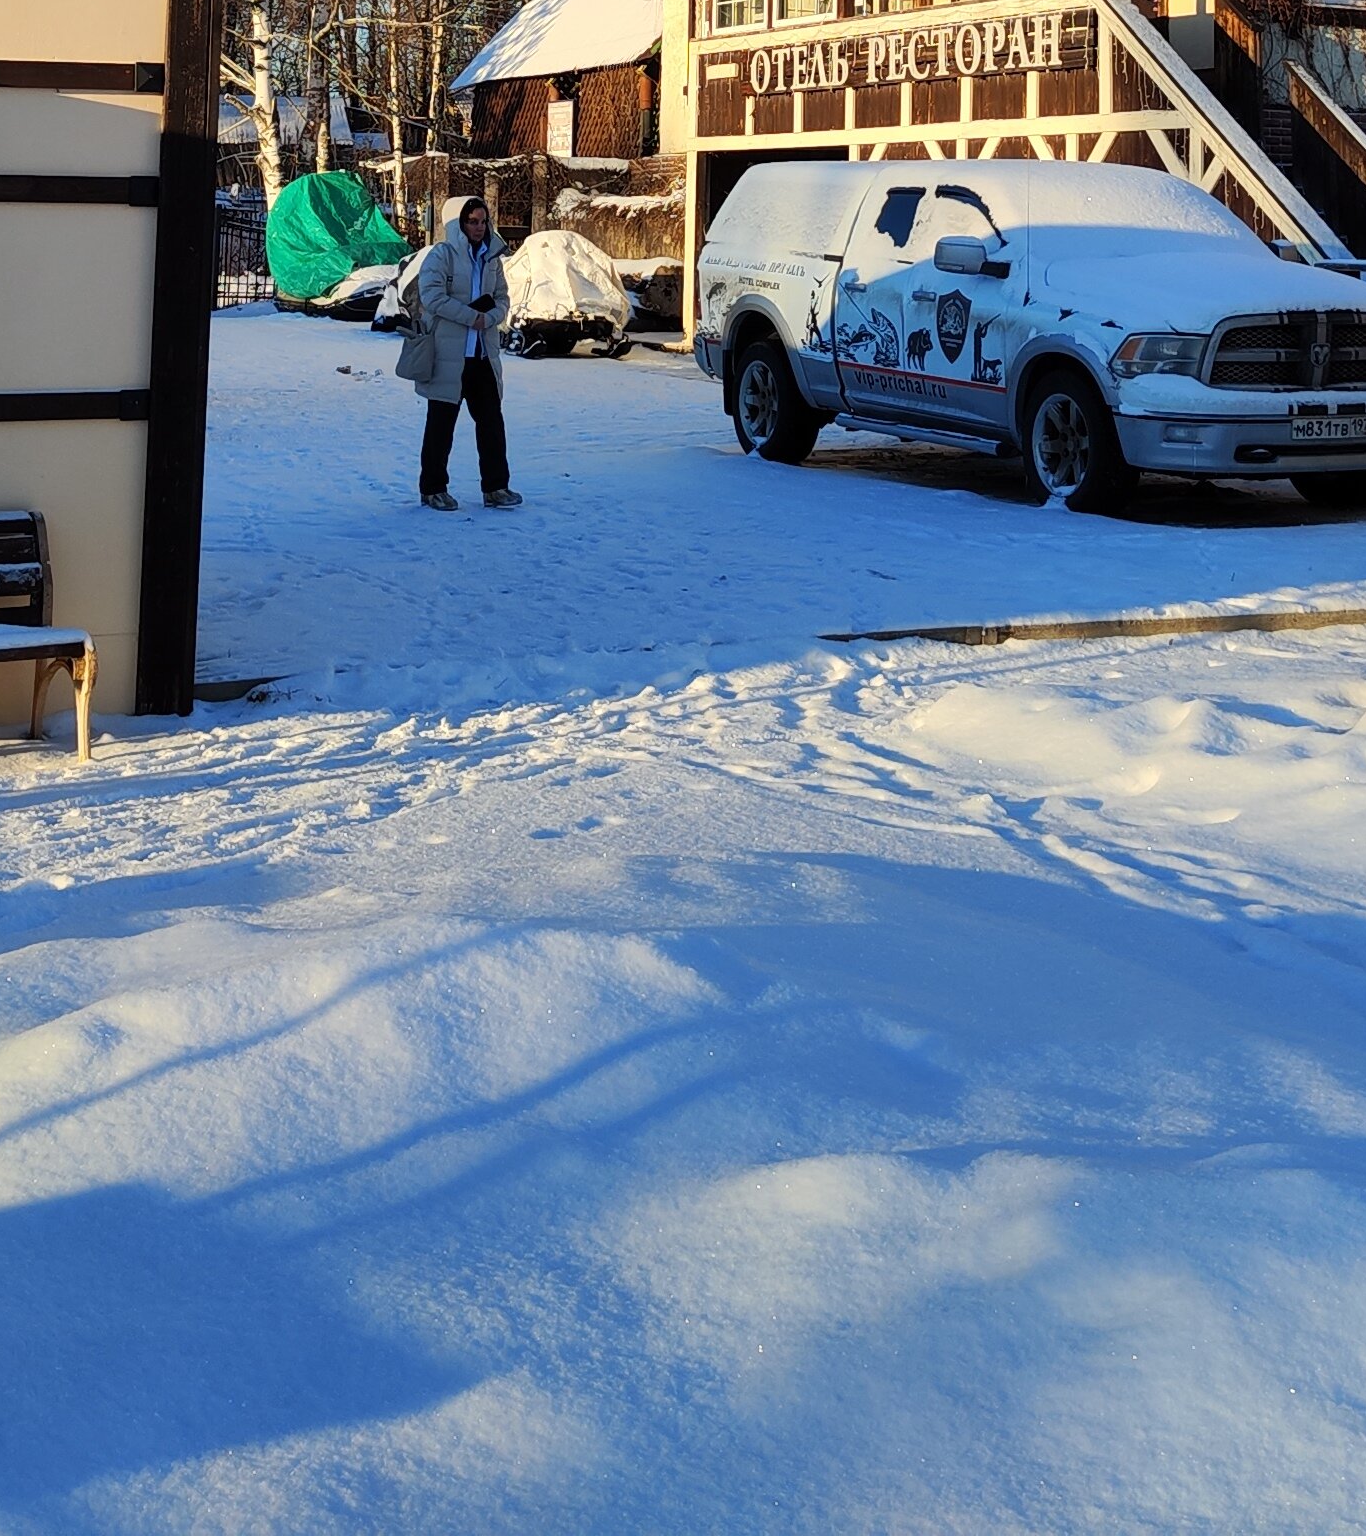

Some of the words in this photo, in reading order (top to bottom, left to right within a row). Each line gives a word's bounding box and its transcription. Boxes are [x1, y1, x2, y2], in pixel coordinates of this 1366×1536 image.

[750, 43, 849, 93] ОТЕЛЬ
[865, 14, 1062, 84] РЕСТОРАН
[739, 276, 754, 287] HOTEL
[755, 279, 780, 290] COMPLEX
[854, 368, 947, 399] vip-prichal.ru
